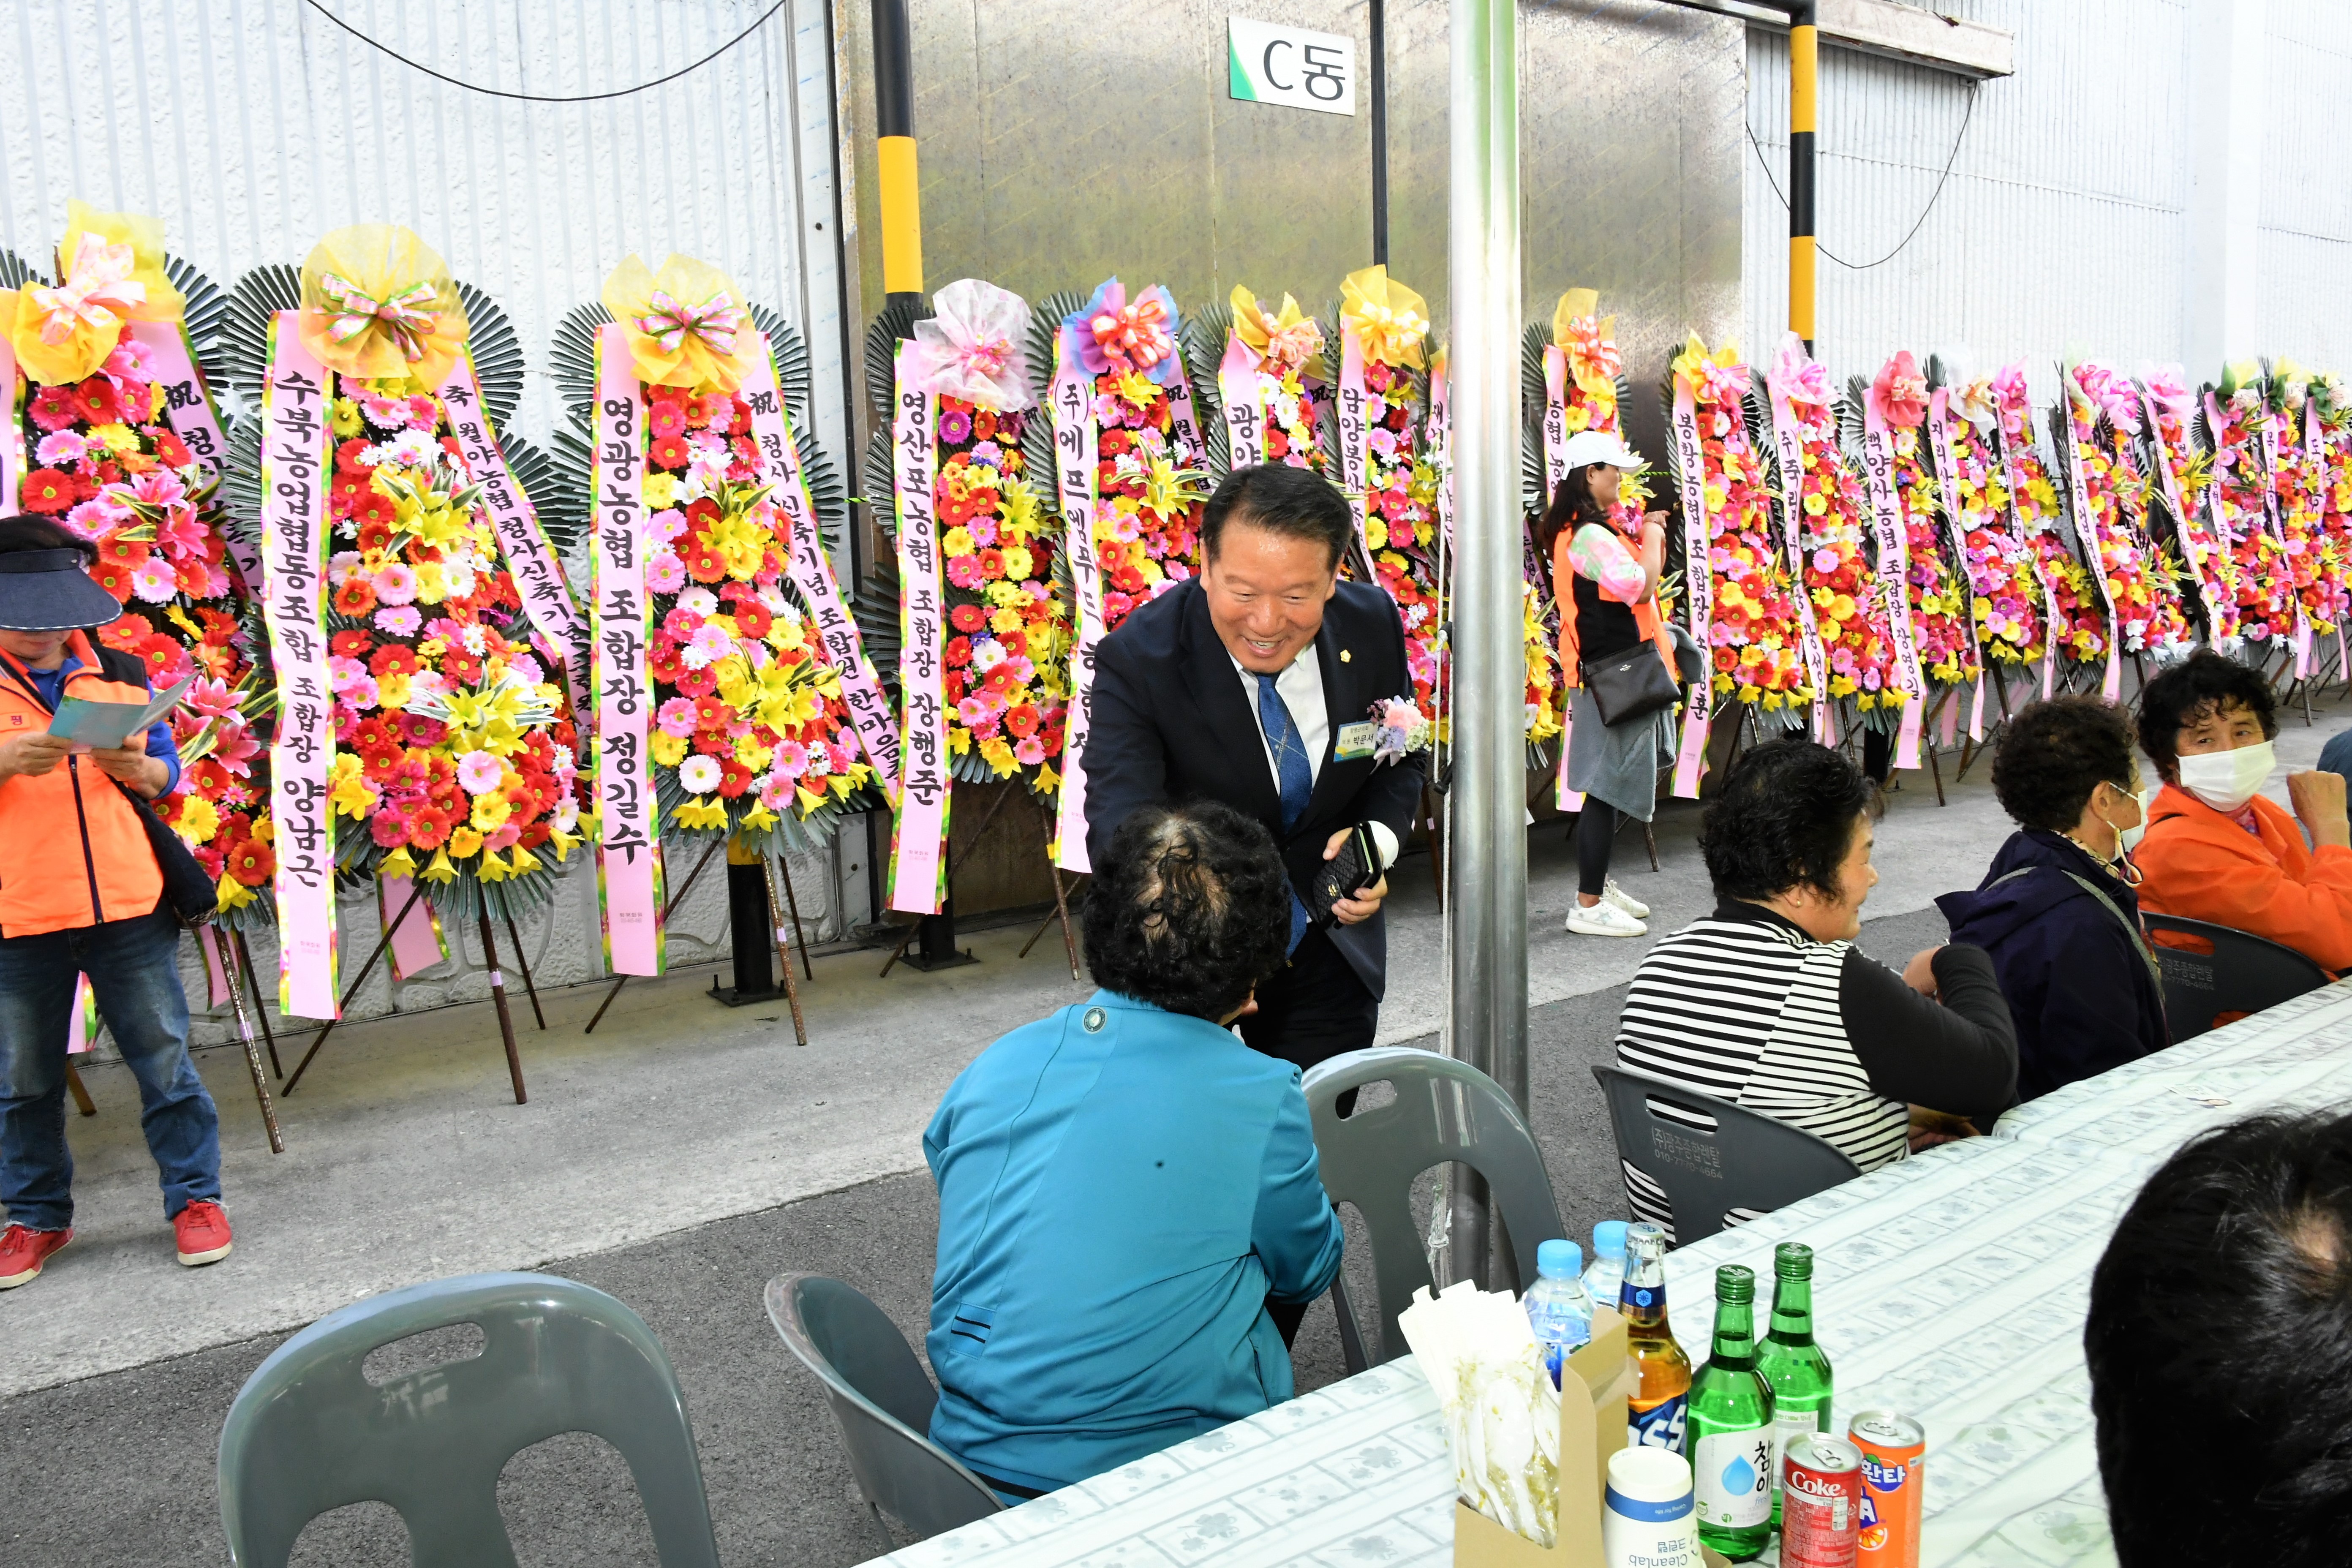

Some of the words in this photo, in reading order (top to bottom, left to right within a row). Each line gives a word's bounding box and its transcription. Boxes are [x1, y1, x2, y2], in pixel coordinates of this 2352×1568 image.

[1263, 40, 1345, 101] C동
[164, 380, 202, 411] 祝
[443, 385, 474, 408] 축
[749, 391, 779, 416] 祝
[458, 422, 513, 509] 월야농협
[599, 397, 641, 569] 영광농협
[761, 433, 797, 484] 청사
[899, 391, 933, 574] 영산포농협
[273, 371, 321, 663] 수북농업협동조합
[1867, 431, 1898, 551] 백양사농협
[1883, 559, 1904, 618] 조합장
[1690, 538, 1710, 622] 조합장
[599, 589, 645, 716] 조합장
[909, 590, 937, 678] 조합장
[1690, 632, 1708, 721] 소훈
[283, 677, 323, 763] 조합장
[906, 692, 942, 806] 장행준
[1353, 733, 1374, 745] 박문서
[283, 777, 327, 887] 양남근
[601, 732, 648, 866] 정길수
[1652, 1125, 1720, 1168] (주)광주종합렌탈
[1792, 1470, 1841, 1497] Coke
[1628, 1554, 1688, 1568] Cleanlab
[1658, 1538, 1686, 1554] 크린랩
